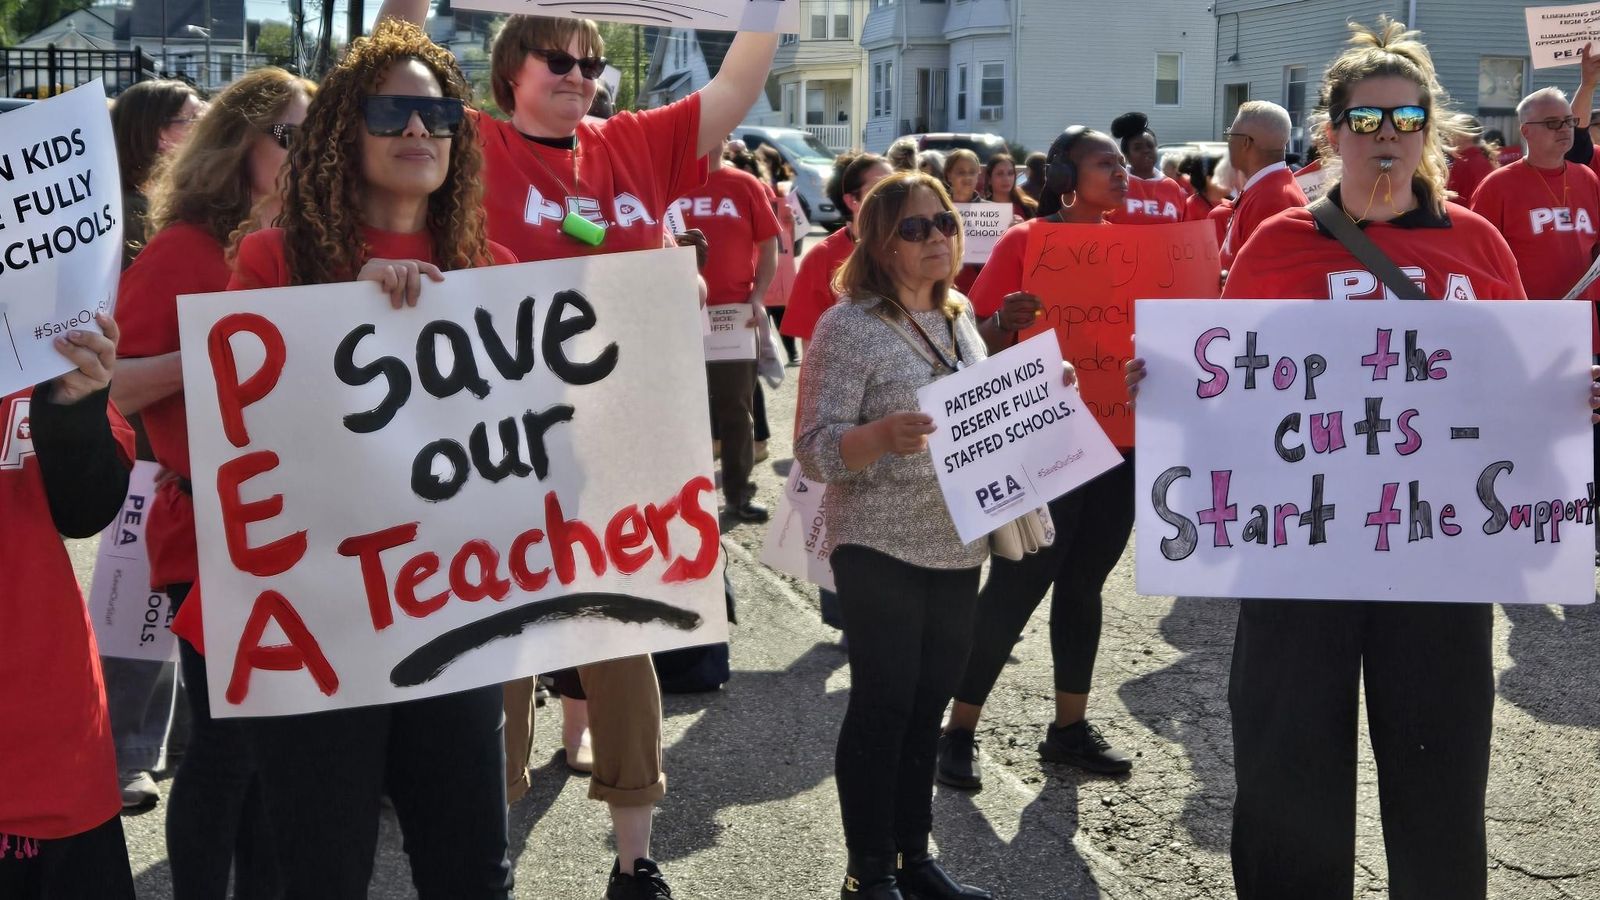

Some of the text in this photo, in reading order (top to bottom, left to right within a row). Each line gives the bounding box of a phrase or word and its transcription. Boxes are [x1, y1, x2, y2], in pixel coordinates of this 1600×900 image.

[22, 128, 86, 174] KIDS
[13, 169, 92, 223] FULLY
[1031, 230, 1139, 288] Every
[945, 358, 1045, 417] PATERSON KIDS
[1194, 327, 1327, 400] Stop
[1361, 328, 1452, 382] the
[944, 401, 1076, 474] STAFFED SCHOOLS.
[951, 381, 1050, 442] DESERVE FULLY
[1274, 397, 1422, 463] cuts
[411, 404, 575, 503] our
[1151, 460, 1594, 561] Start the Support
[337, 476, 721, 632] Teachers
[139, 592, 162, 647] OOLS.
